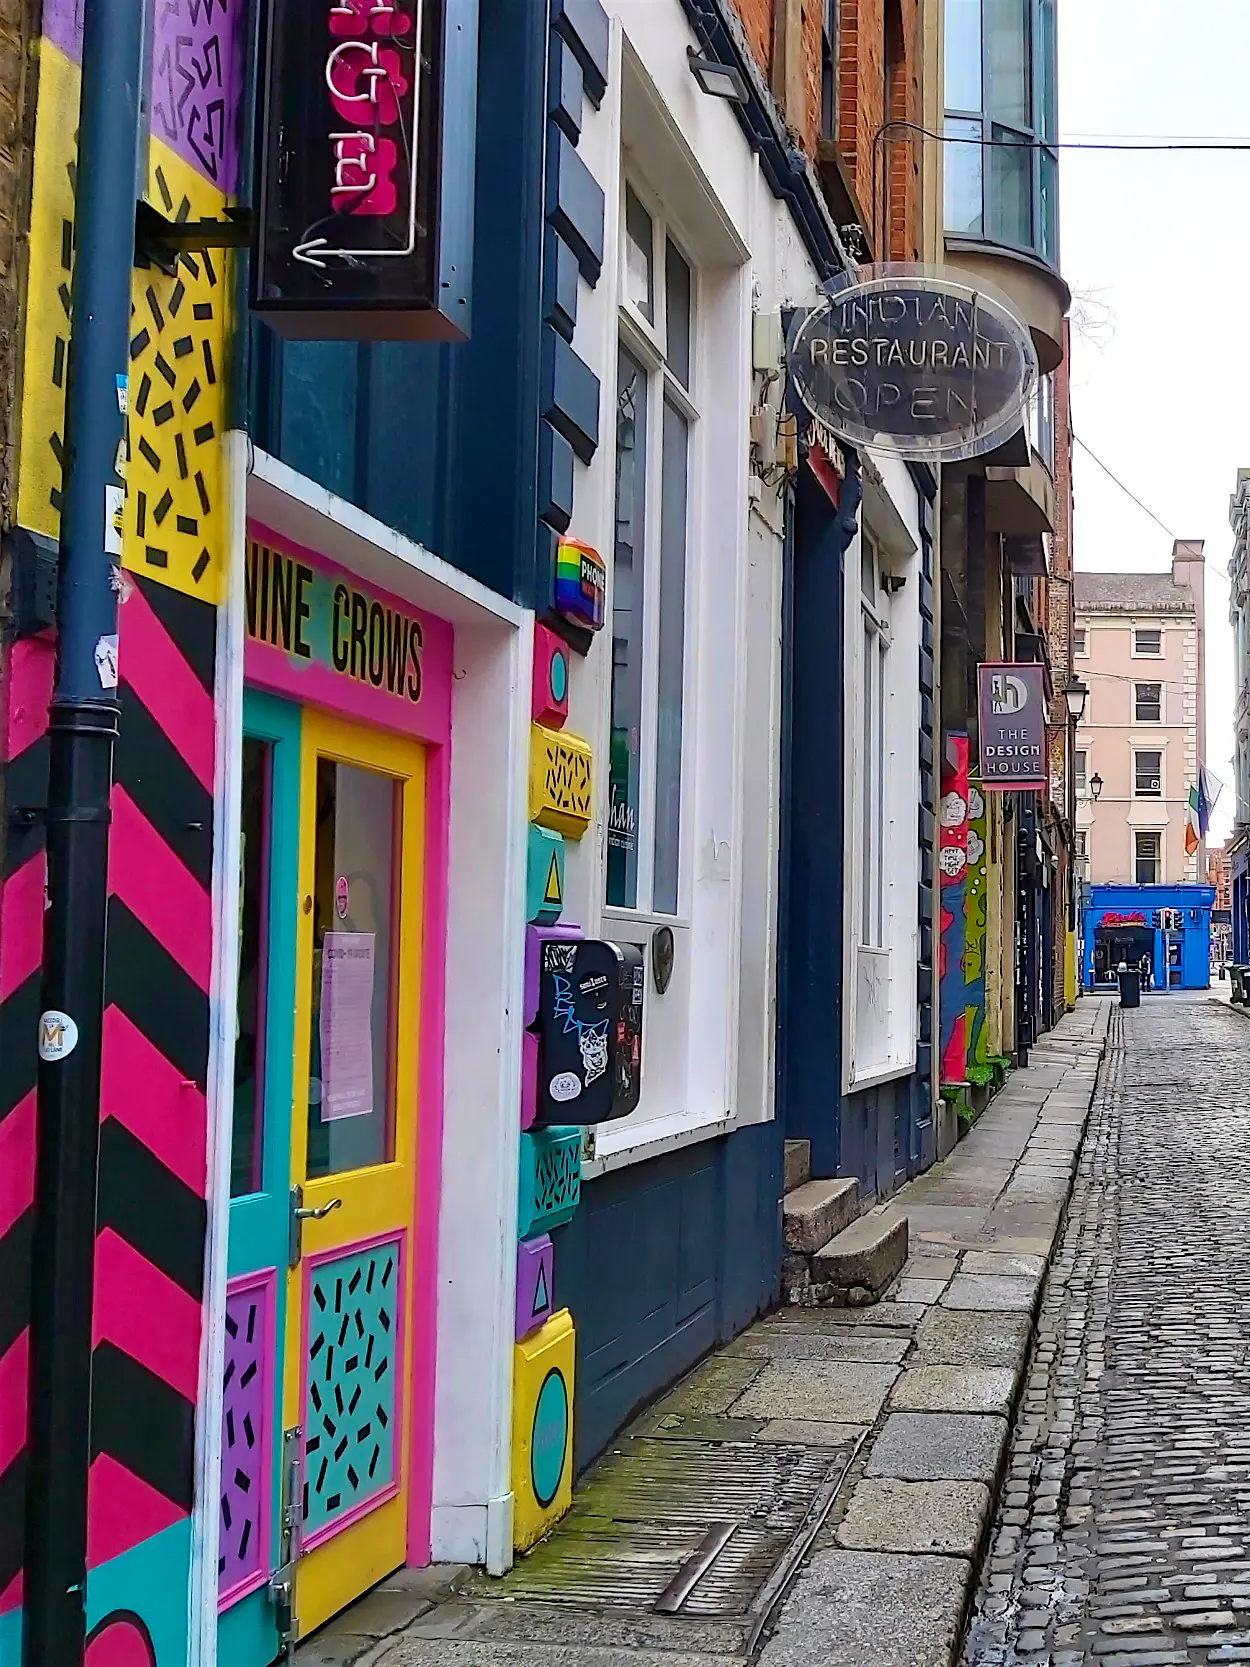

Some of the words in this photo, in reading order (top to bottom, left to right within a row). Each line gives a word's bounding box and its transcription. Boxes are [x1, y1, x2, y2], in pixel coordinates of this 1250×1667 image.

[841, 295, 976, 334] INDIAN
[809, 337, 1012, 371] RESTAURANT
[833, 377, 976, 420] OPEN
[581, 559, 605, 592] PHONE
[244, 540, 313, 660] NINE
[332, 583, 423, 702] CROWS
[998, 729, 1029, 740] THE
[985, 745, 1041, 758] DESIGN
[986, 761, 1041, 774] HOUSE
